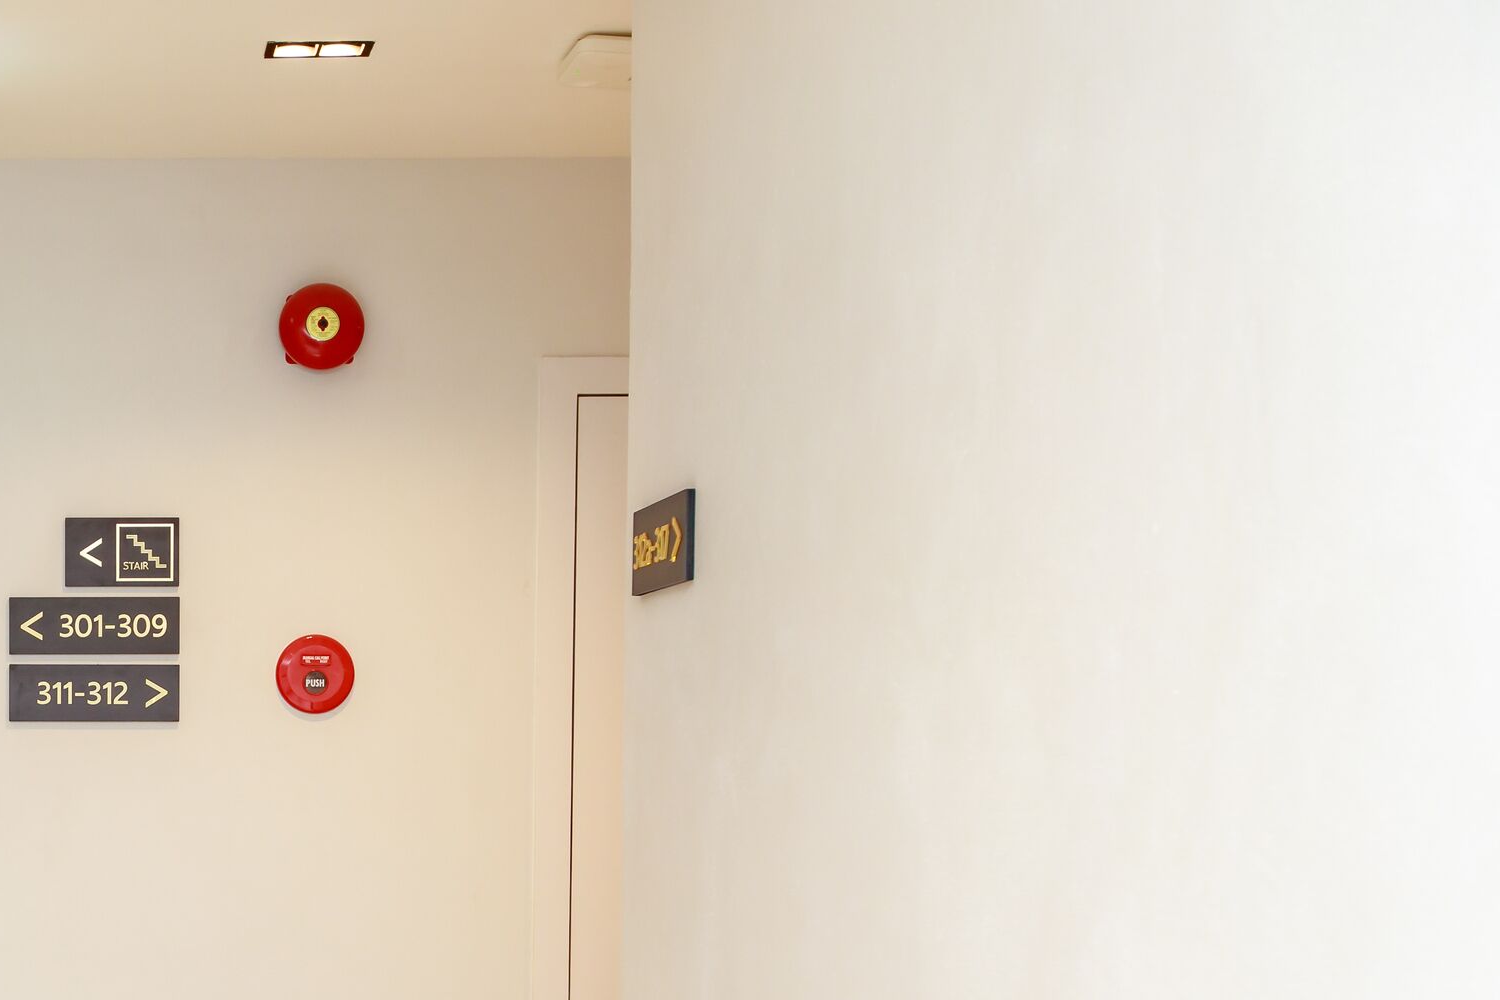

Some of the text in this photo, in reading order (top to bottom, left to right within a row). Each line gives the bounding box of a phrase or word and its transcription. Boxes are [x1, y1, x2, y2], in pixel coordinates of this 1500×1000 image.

[123, 561, 149, 571] STAIR
[59, 613, 168, 638] 301-309
[305, 678, 325, 688] PUSH
[36, 680, 129, 705] 311-312
